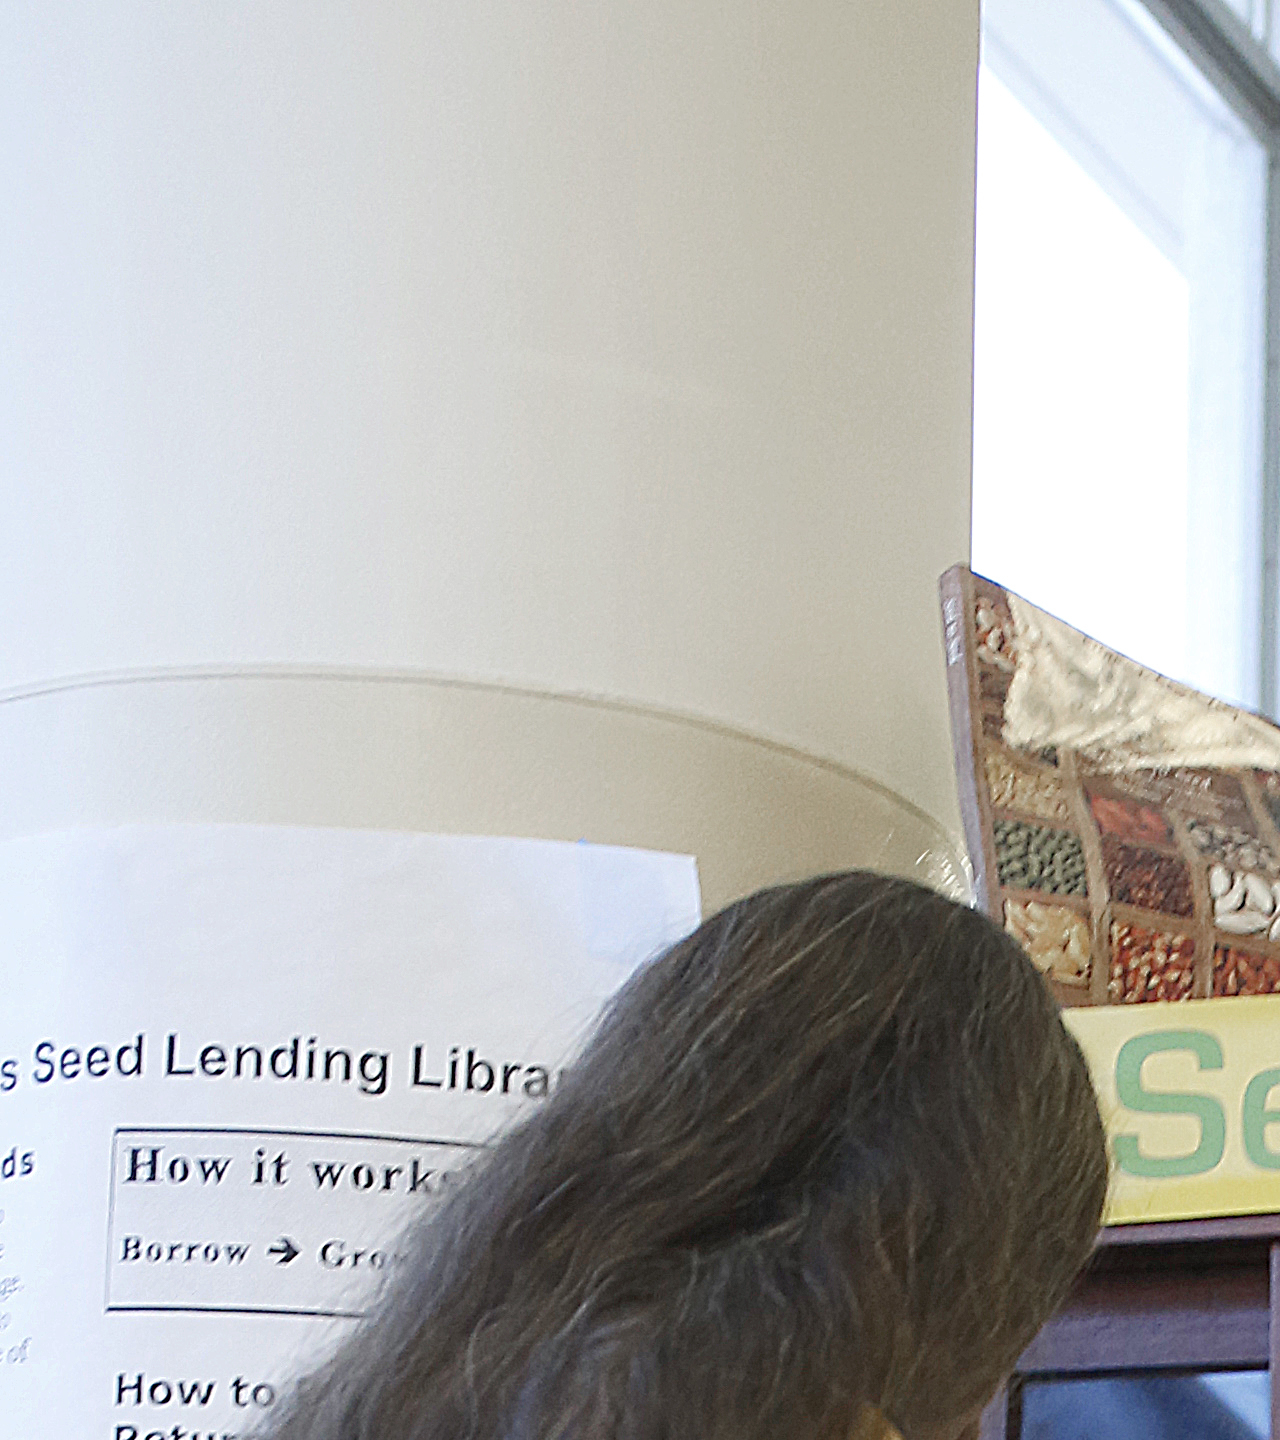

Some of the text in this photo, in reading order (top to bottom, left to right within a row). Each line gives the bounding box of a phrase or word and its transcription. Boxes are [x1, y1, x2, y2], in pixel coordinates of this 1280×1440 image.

[34, 1035, 144, 1079] Seed
[166, 1034, 390, 1095] Lending
[123, 1145, 231, 1186] How
[251, 1147, 289, 1186] it
[119, 1235, 251, 1266] Borrow
[114, 1372, 276, 1407] How to
